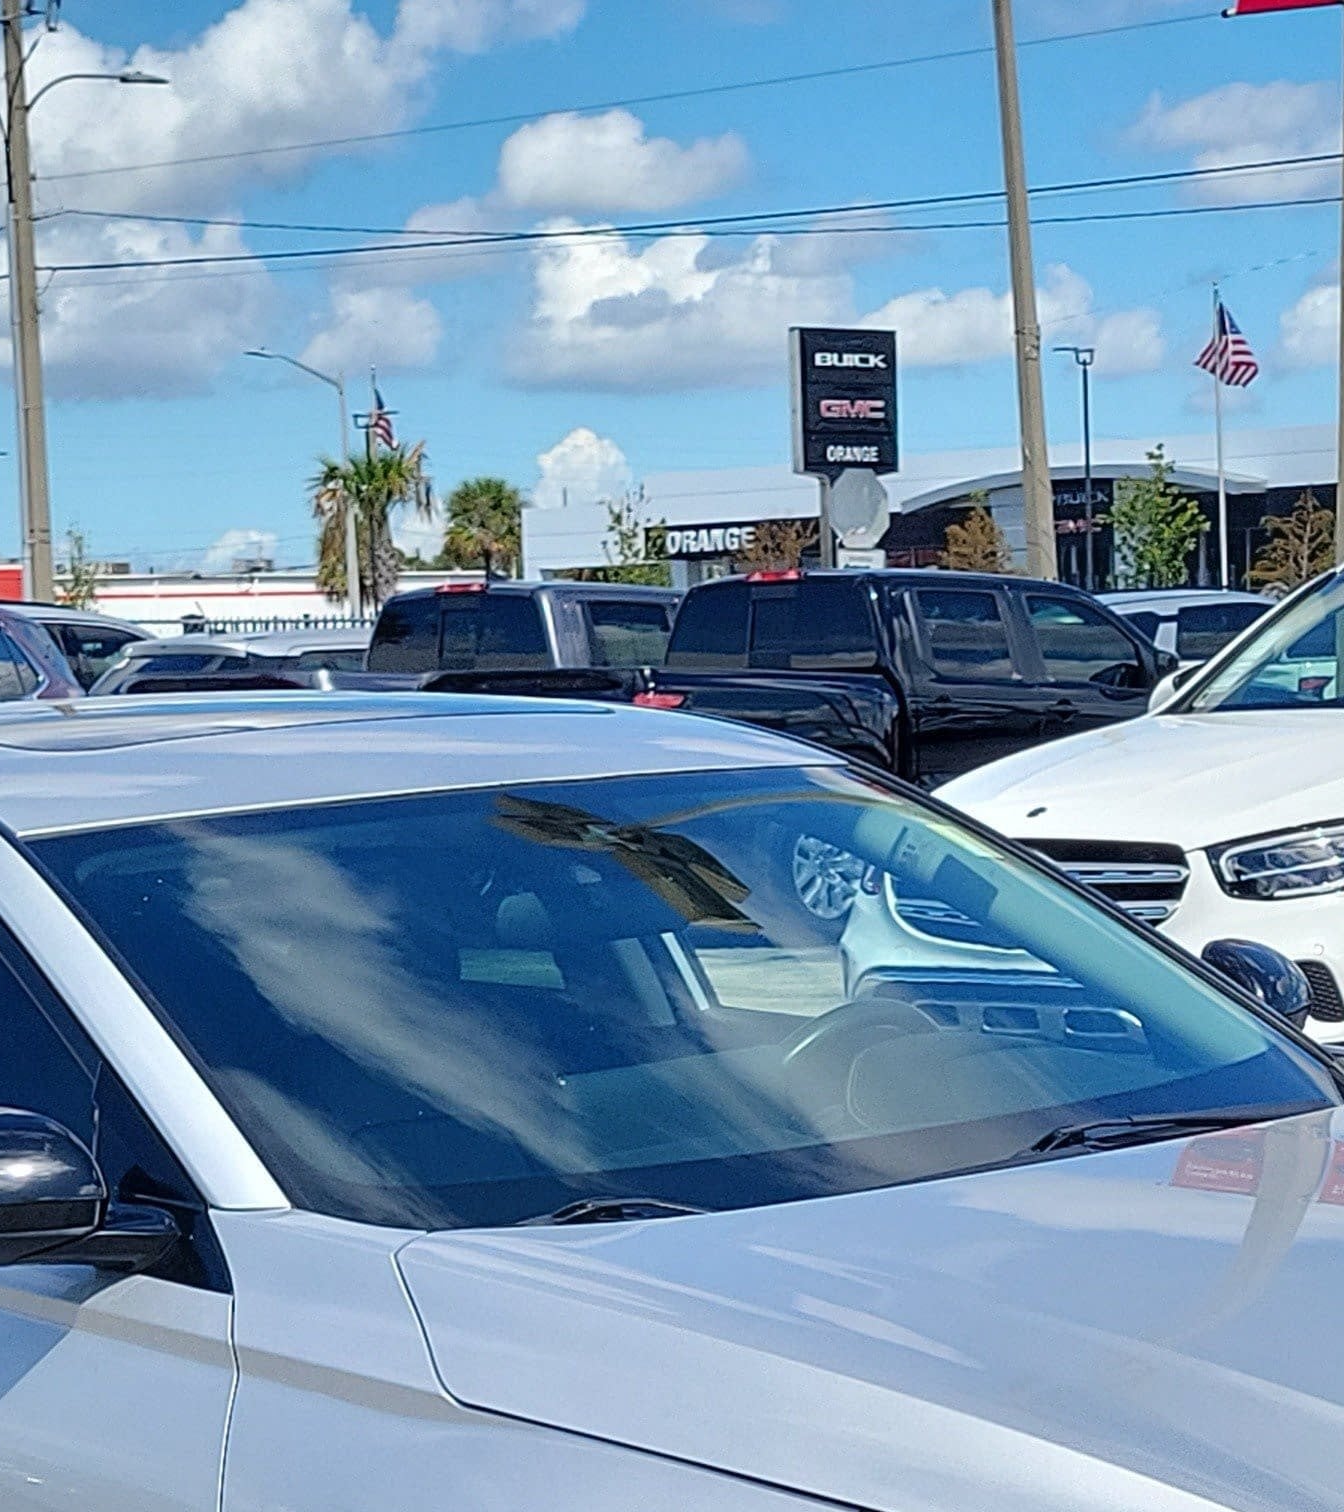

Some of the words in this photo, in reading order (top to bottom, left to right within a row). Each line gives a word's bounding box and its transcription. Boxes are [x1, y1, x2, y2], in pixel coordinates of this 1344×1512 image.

[814, 353, 888, 368] BUICK
[819, 399, 886, 419] GMC
[825, 445, 880, 463] ORANGE
[664, 526, 757, 555] ORANGE
